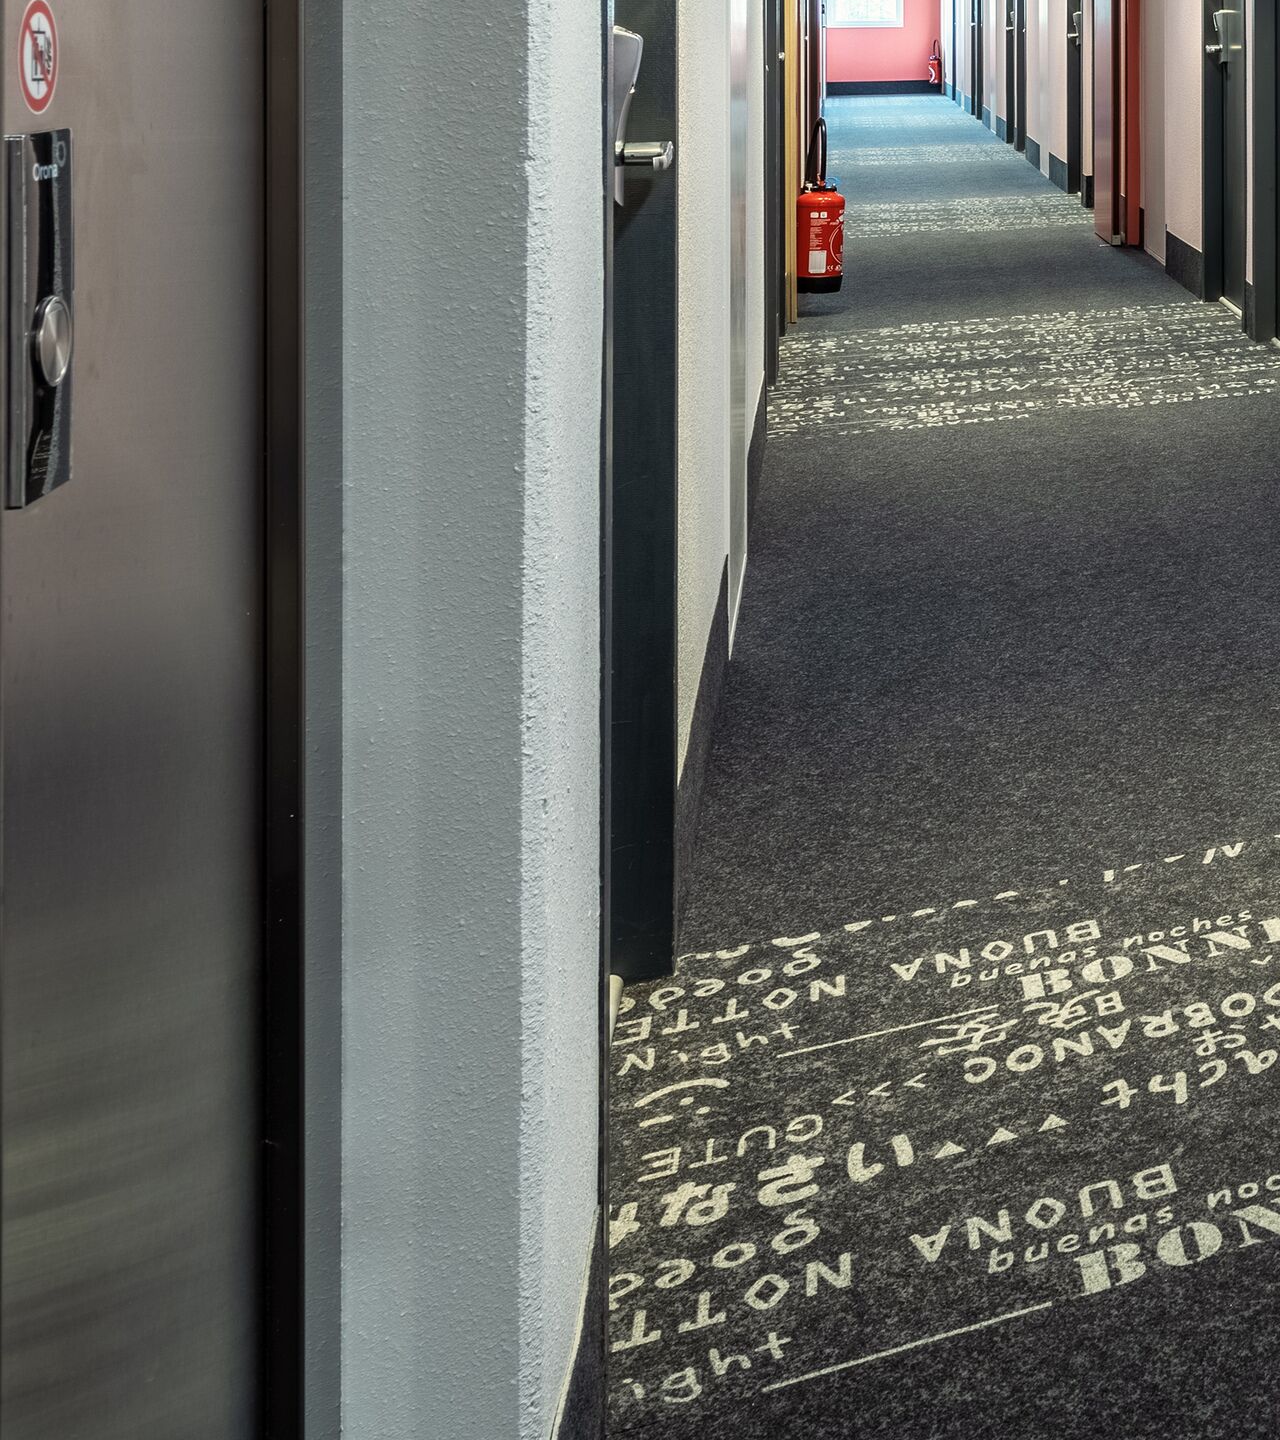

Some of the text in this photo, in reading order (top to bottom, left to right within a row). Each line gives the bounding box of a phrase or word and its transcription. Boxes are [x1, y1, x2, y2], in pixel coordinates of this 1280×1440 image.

[33, 163, 58, 181] Orona
[951, 910, 1252, 987] buenas noches
[610, 920, 1101, 1046] BUONA NOTTE
[618, 1022, 798, 1076] Night
[638, 1114, 823, 1182] GUTE
[910, 1163, 1177, 1261] BUONA
[988, 1206, 1173, 1273] buenas
